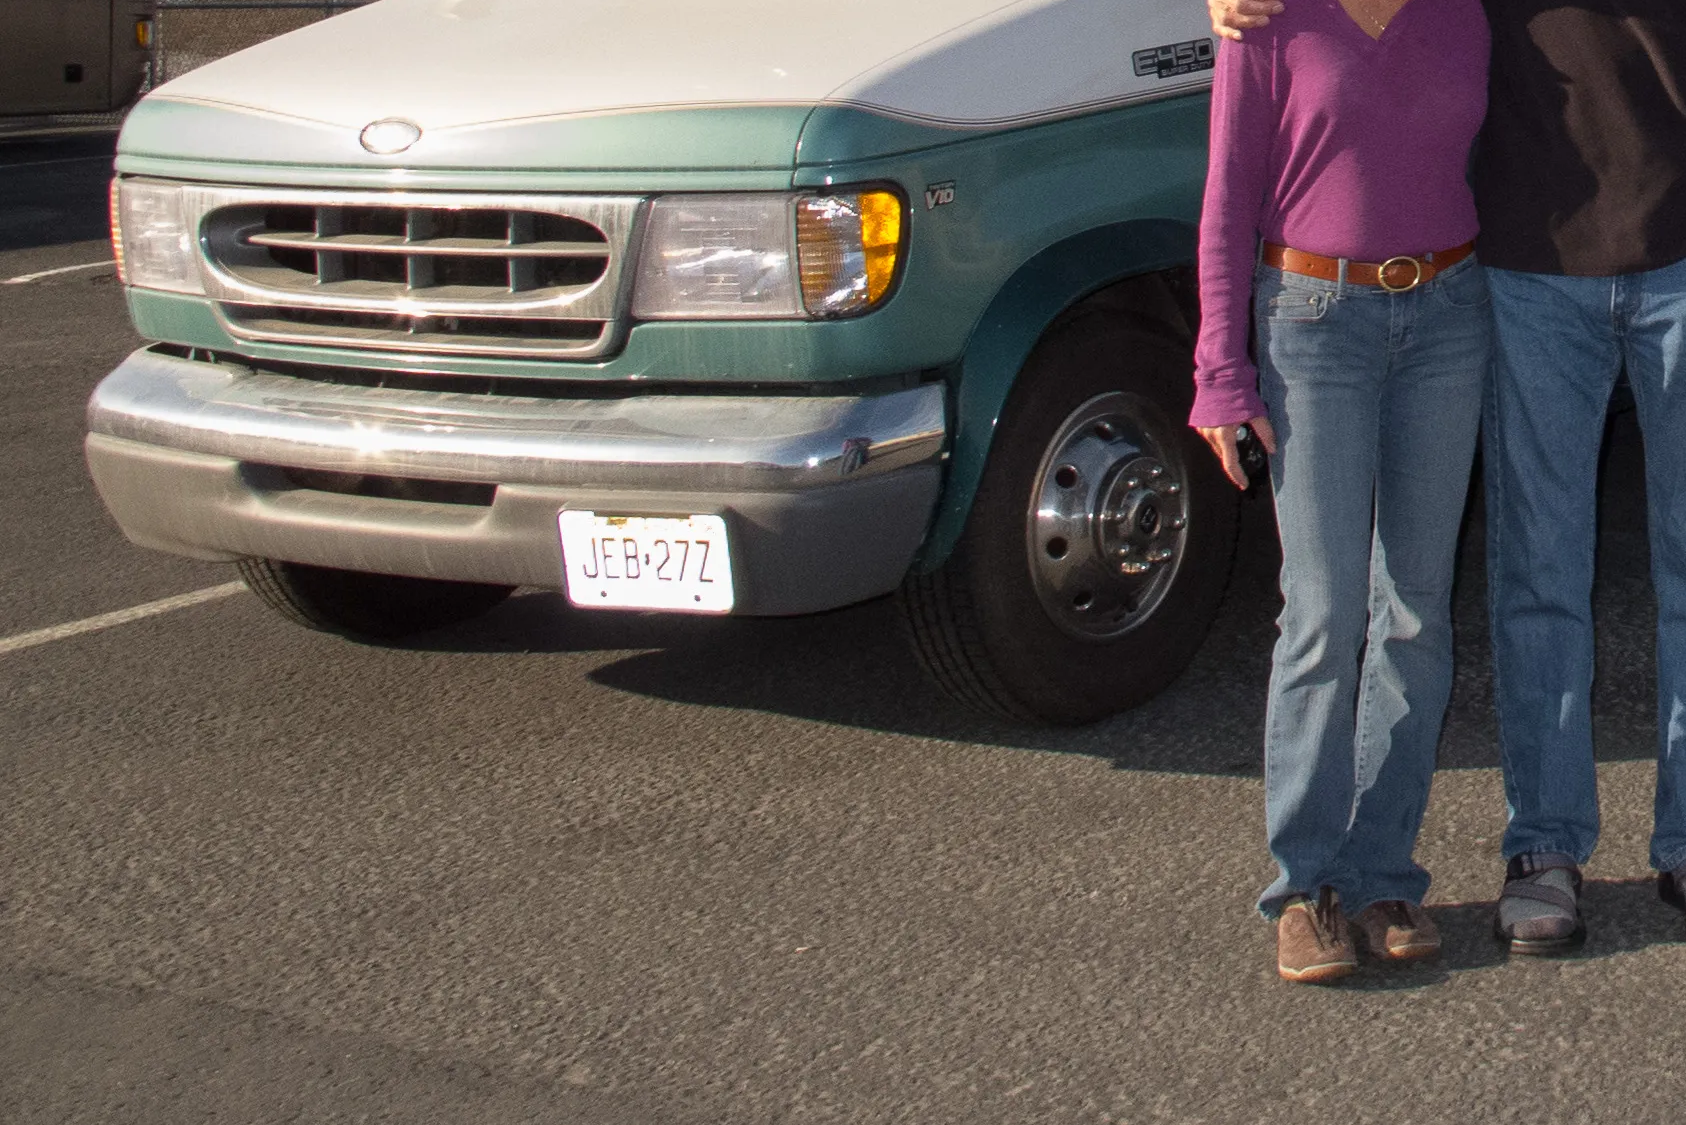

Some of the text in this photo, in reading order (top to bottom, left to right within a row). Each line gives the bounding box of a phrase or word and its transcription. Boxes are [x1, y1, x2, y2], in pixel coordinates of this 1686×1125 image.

[1161, 60, 1212, 76] SUPER DUTY
[925, 187, 954, 209] V10
